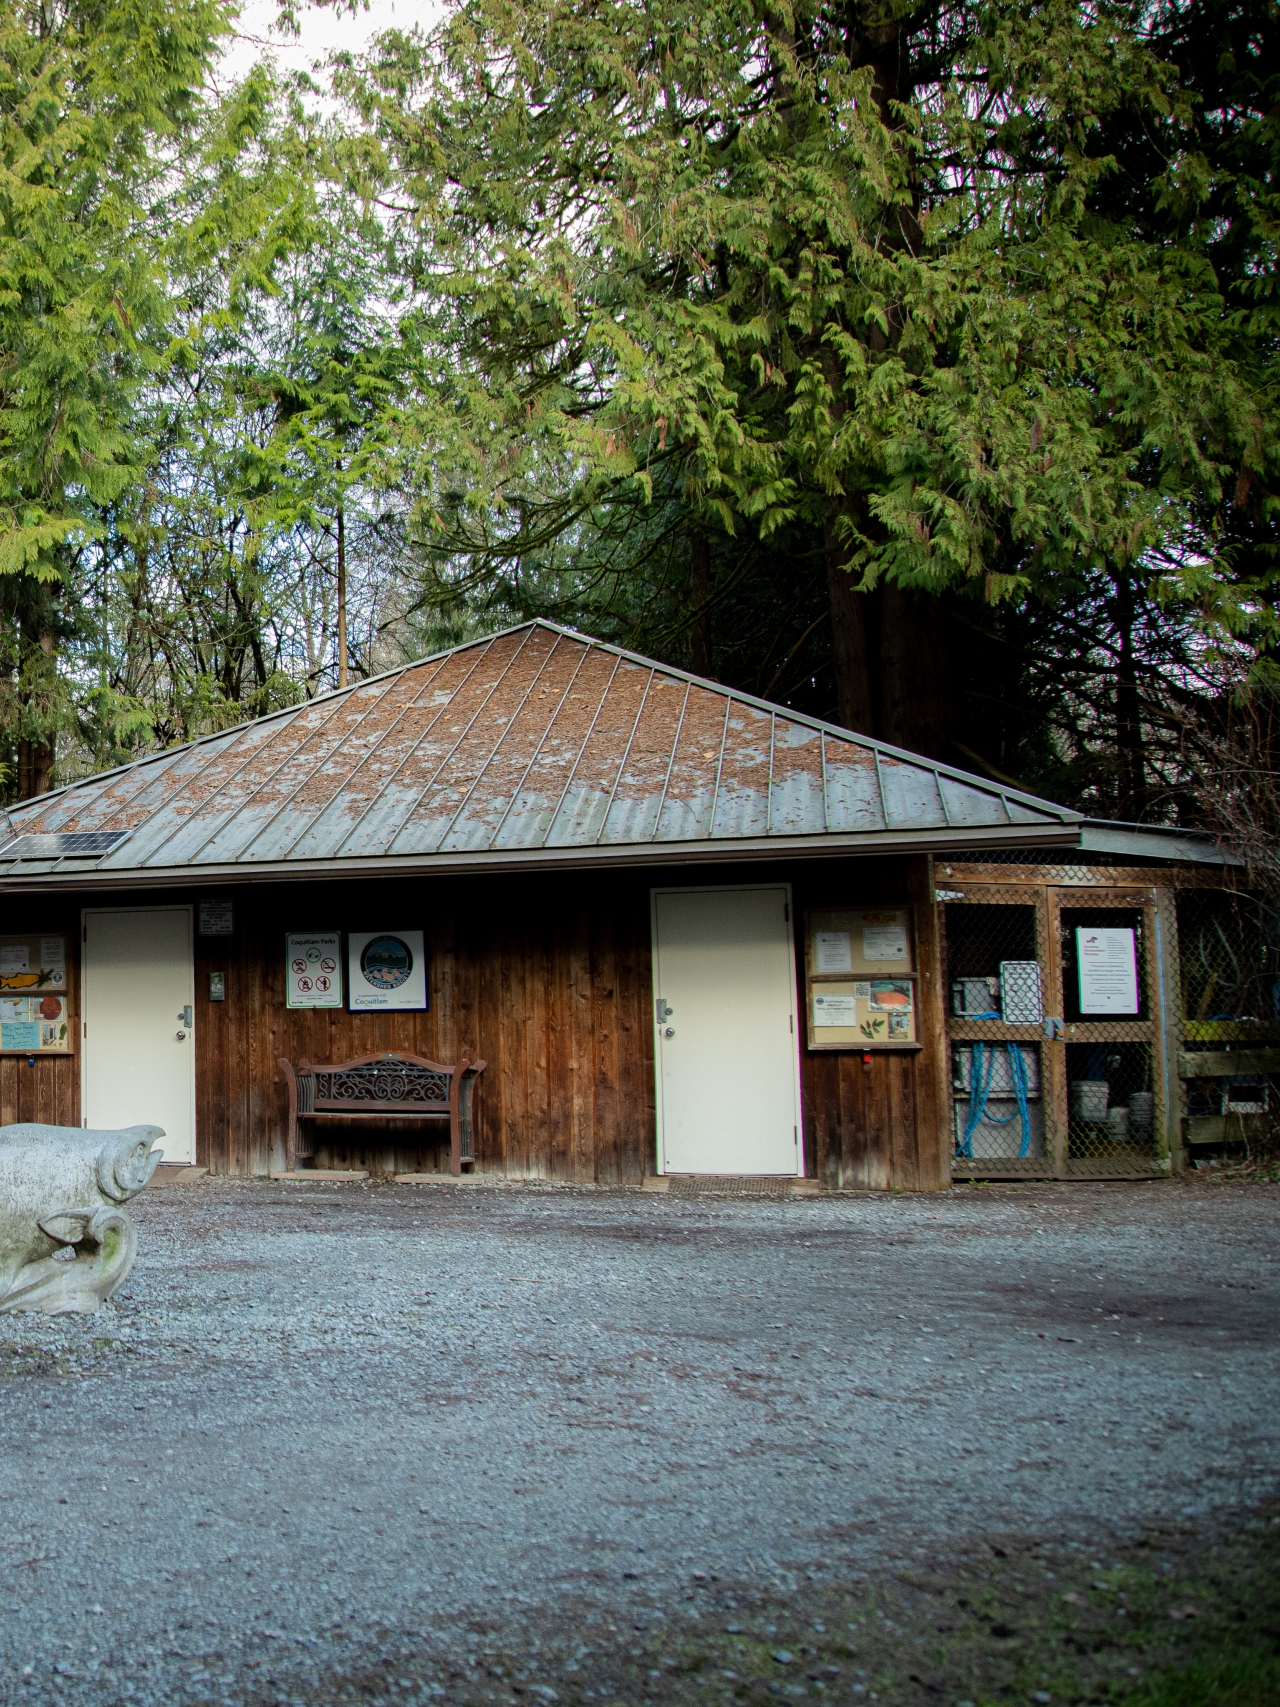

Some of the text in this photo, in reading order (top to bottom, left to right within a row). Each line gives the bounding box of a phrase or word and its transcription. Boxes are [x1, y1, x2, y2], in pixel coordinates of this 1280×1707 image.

[363, 970, 392, 989] WATERSHED
[392, 969, 411, 989] SOCIETY
[355, 998, 388, 1007] Coquitlam
